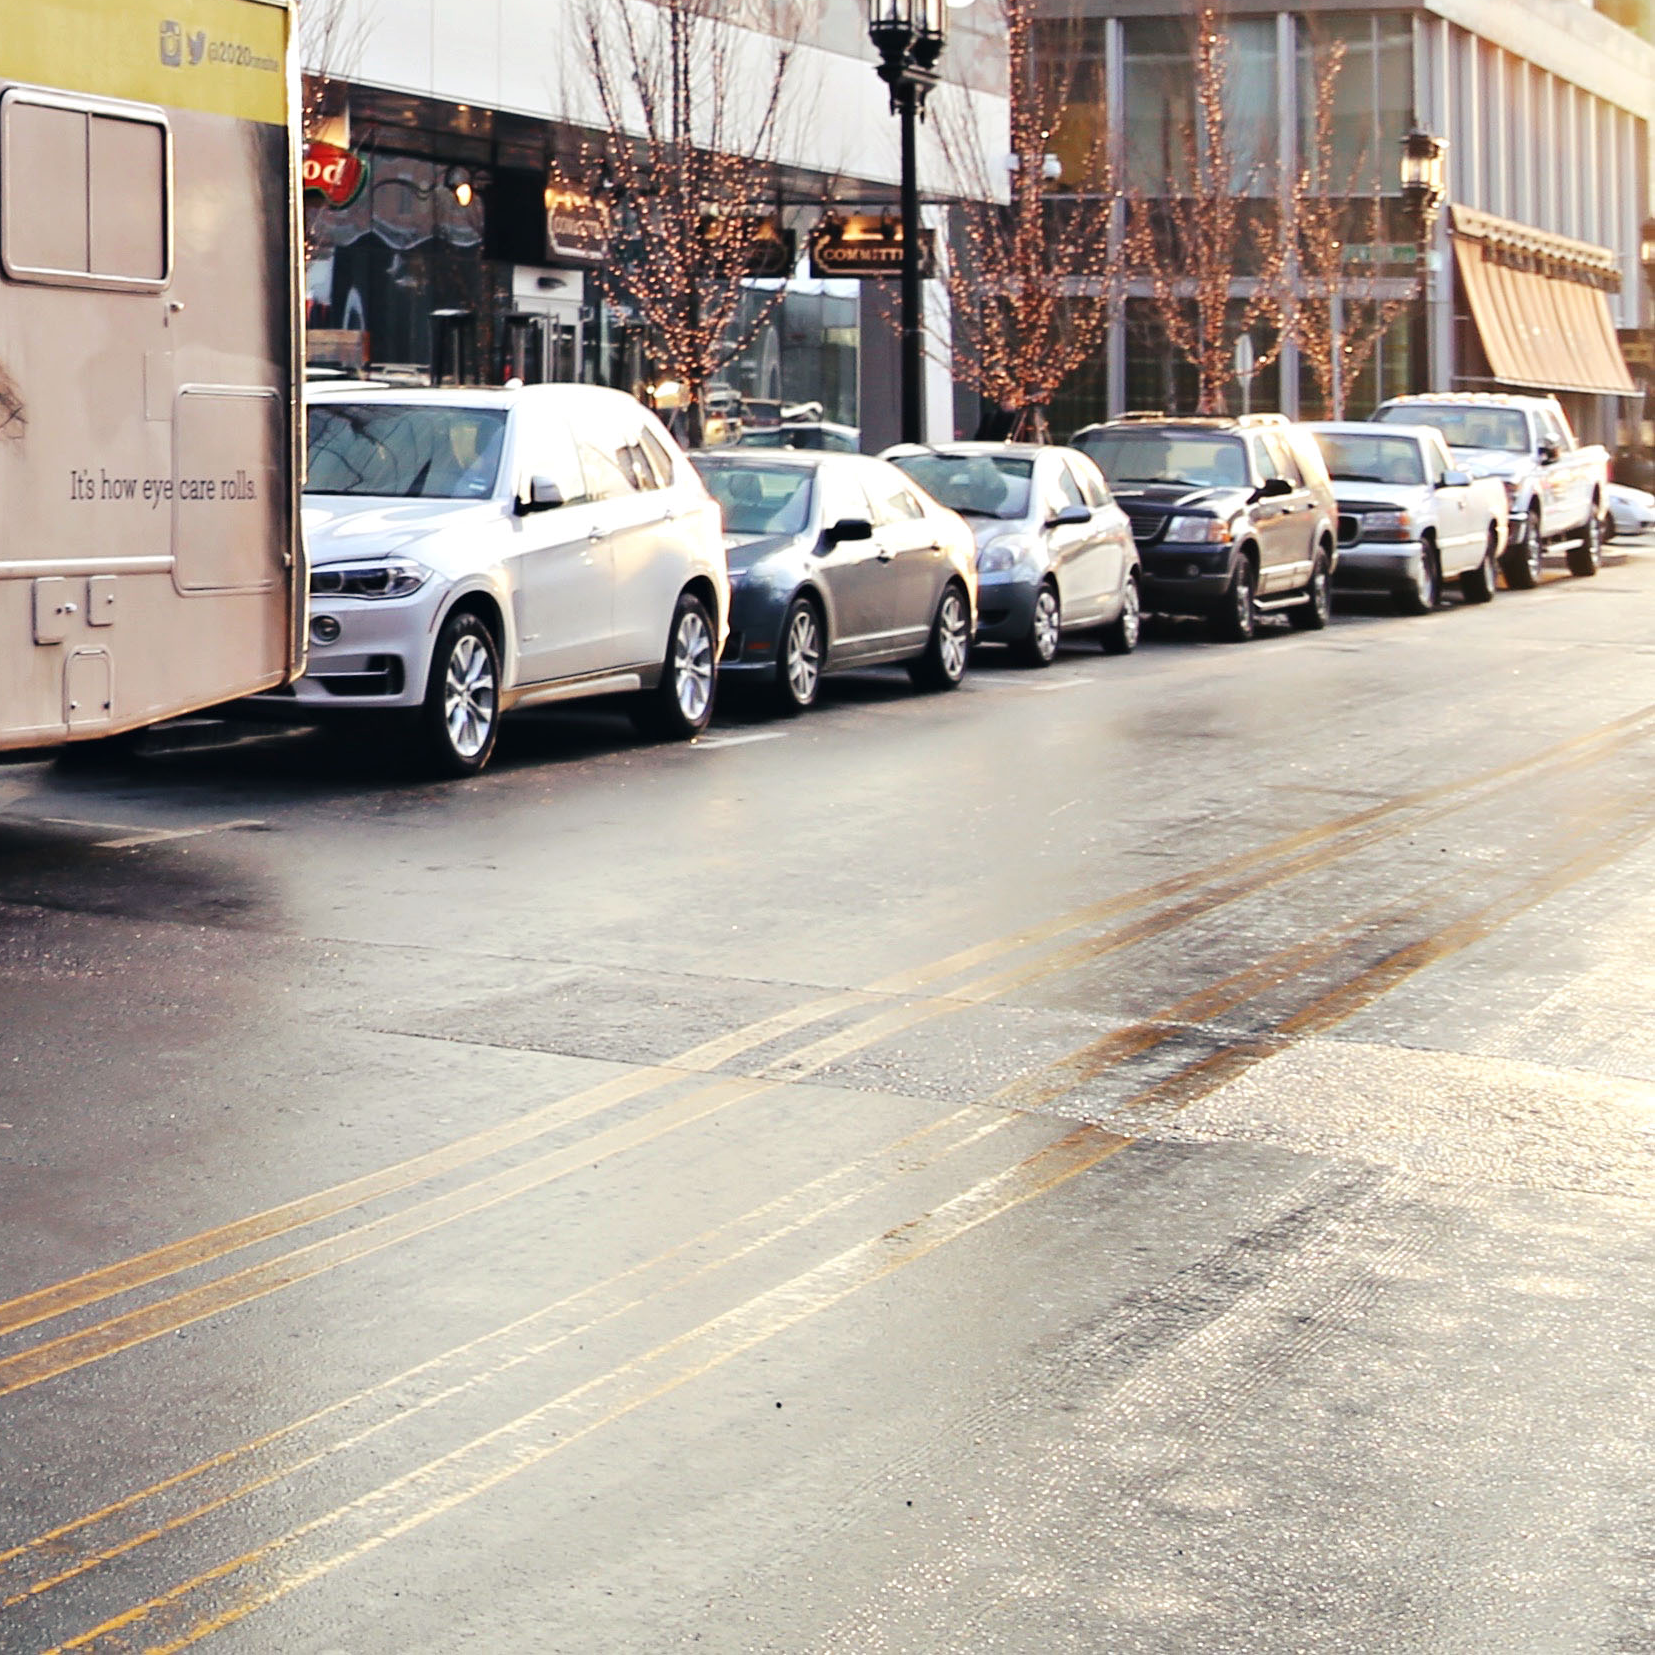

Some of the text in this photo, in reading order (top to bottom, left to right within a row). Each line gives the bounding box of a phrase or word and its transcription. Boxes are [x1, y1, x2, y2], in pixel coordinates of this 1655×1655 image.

[823, 247, 903, 261] COMMITT
[70, 469, 95, 500] It's
[100, 468, 138, 500] how
[142, 478, 174, 510] eye
[179, 478, 216, 500] care
